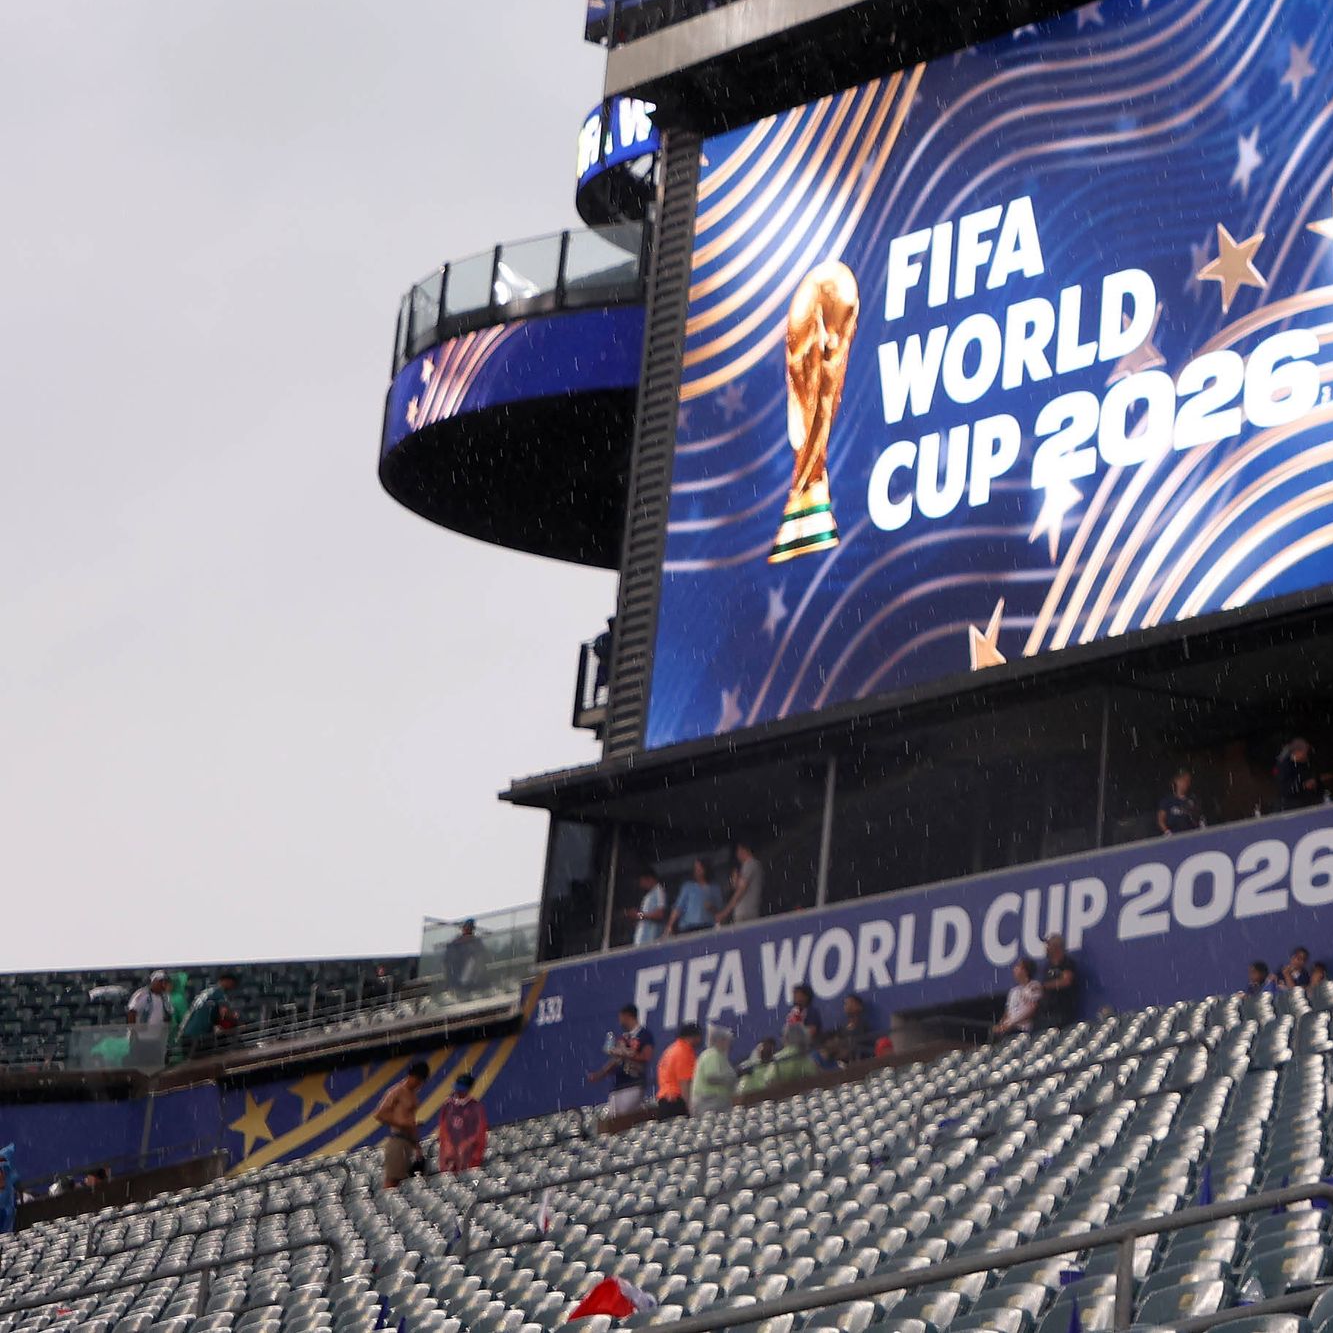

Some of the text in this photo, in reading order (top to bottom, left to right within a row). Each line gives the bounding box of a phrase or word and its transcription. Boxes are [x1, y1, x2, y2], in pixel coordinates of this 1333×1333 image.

[884, 195, 1045, 322] FIFA
[878, 268, 1157, 425] WORLD
[867, 328, 1321, 532] CUP 2026
[634, 948, 748, 1032] FIFA
[760, 904, 973, 1011] WORLD
[981, 875, 1107, 966] CUP
